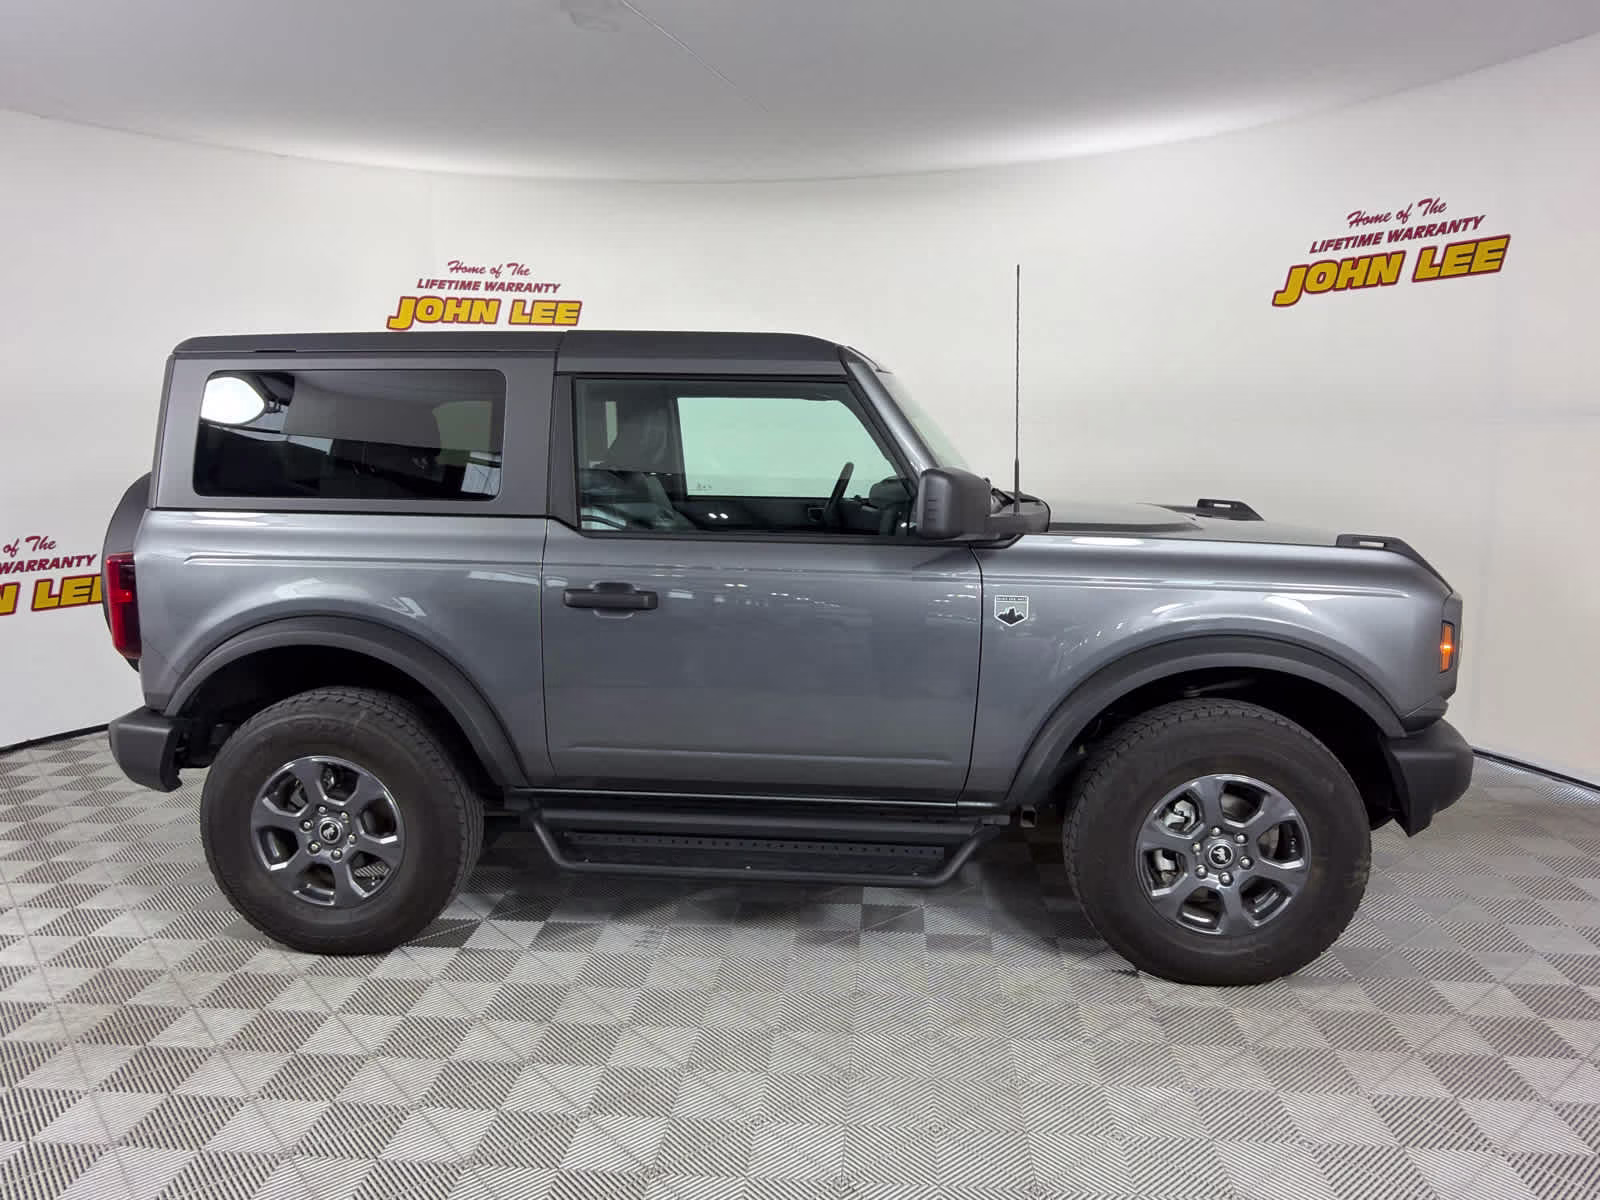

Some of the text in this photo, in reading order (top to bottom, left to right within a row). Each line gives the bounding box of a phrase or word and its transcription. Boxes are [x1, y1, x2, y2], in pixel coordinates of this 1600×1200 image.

[1347, 197, 1447, 228] Home of The
[1309, 215, 1486, 254] LIFETIME WARRANTY
[448, 260, 530, 279] Home of The
[1272, 233, 1511, 307] JOHN LEE
[417, 278, 561, 294] LIFETIME WARRANTY
[386, 296, 583, 331] JOHN LEE
[2, 535, 57, 558] of The
